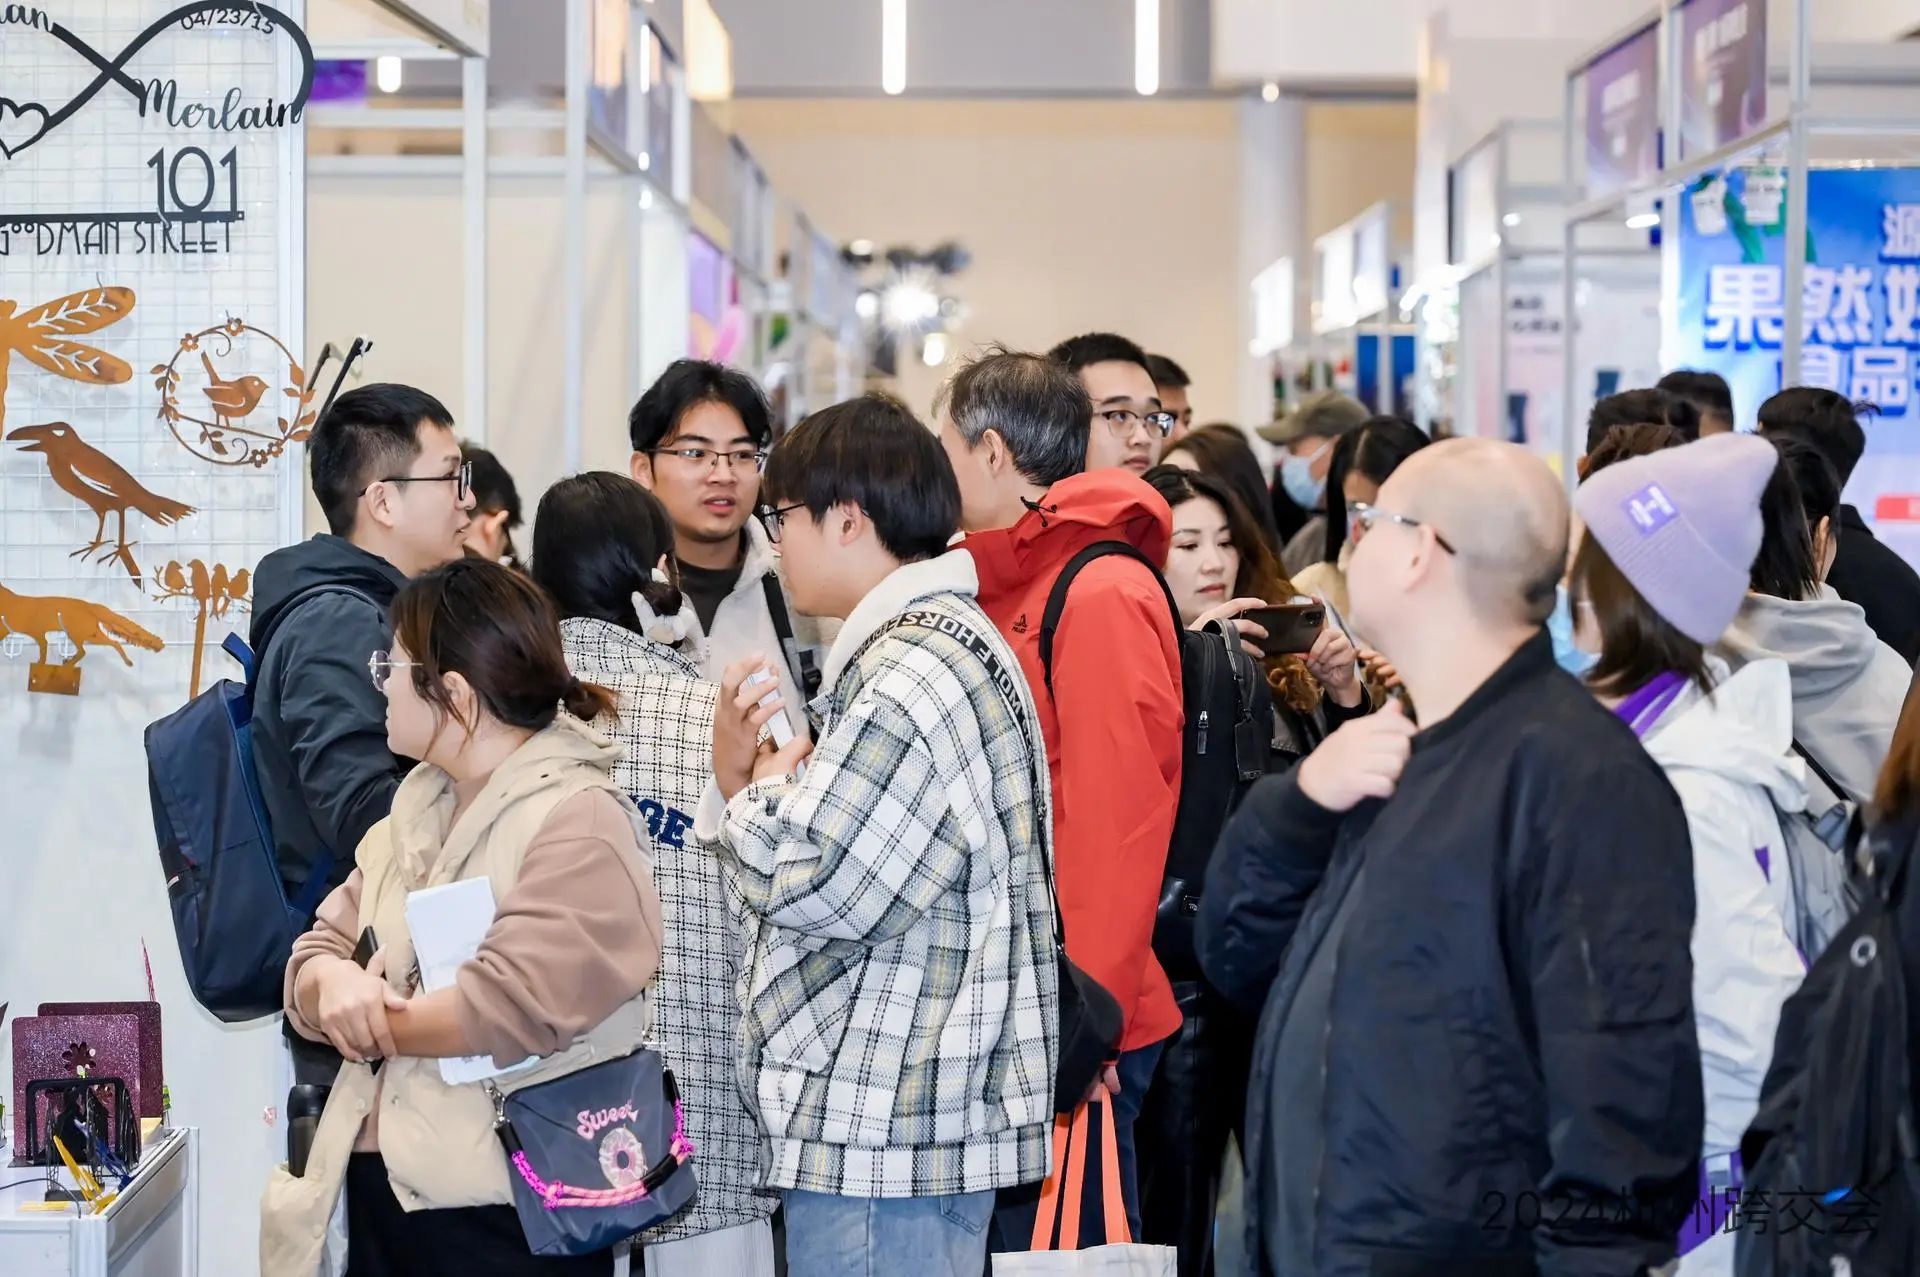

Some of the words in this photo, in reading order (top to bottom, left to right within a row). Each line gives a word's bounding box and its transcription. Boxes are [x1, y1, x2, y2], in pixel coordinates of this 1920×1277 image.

[0, 3, 52, 32] an
[180, 8, 277, 35] 04/23/15
[147, 145, 238, 216] 101
[134, 220, 230, 254] STREET
